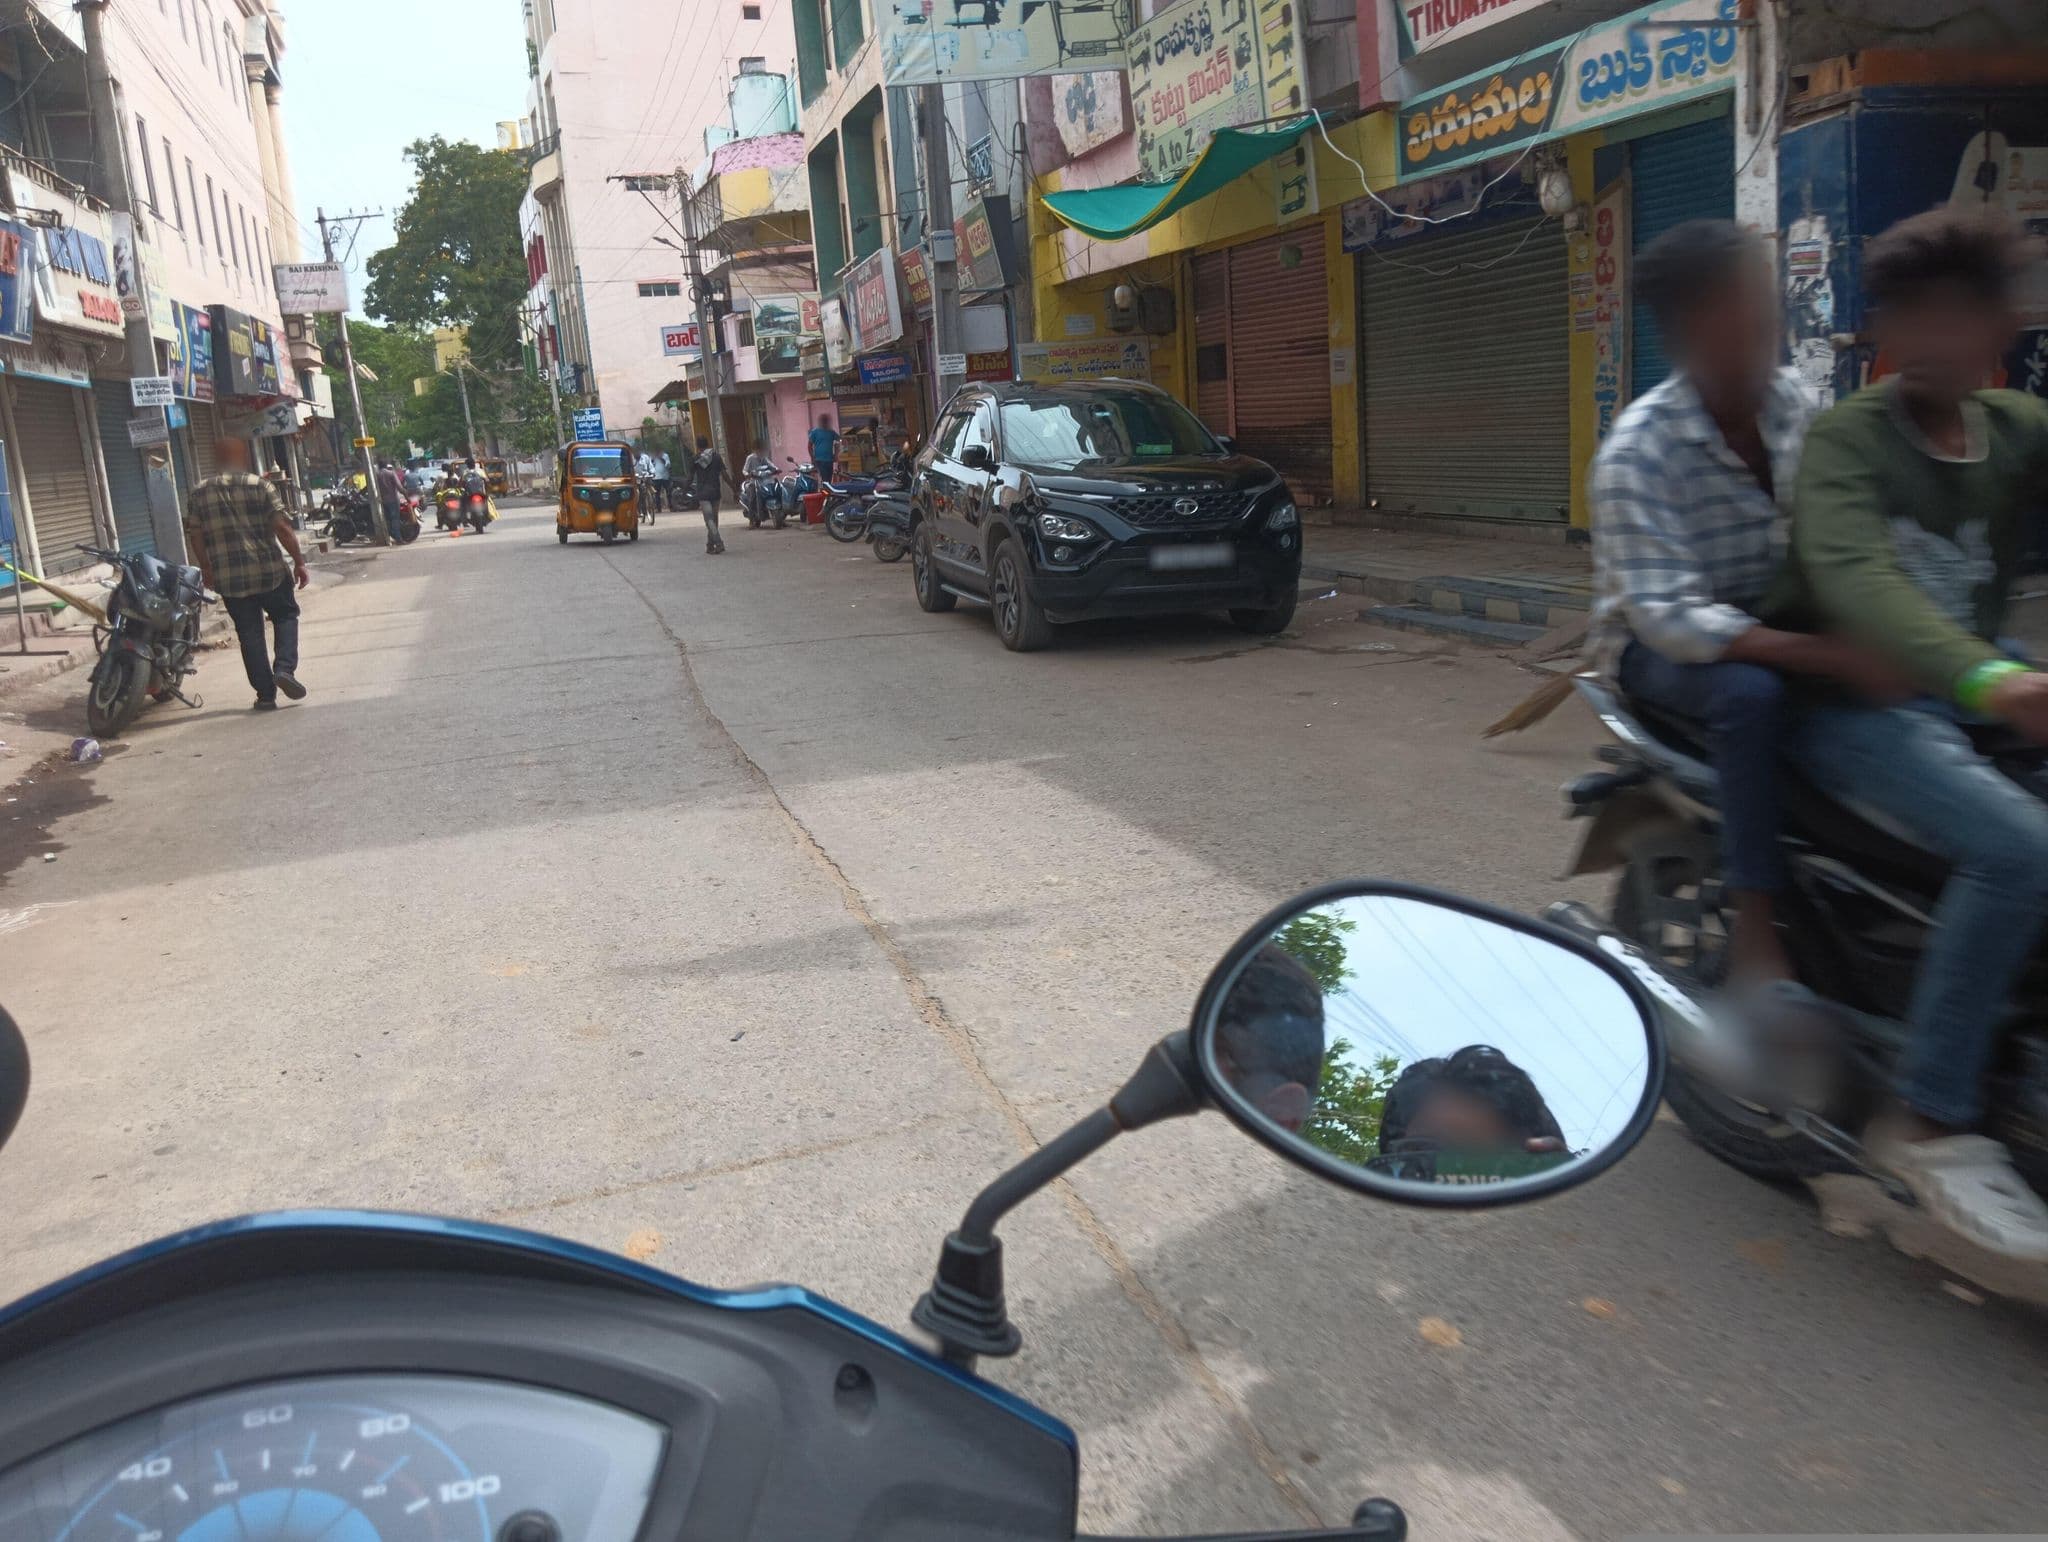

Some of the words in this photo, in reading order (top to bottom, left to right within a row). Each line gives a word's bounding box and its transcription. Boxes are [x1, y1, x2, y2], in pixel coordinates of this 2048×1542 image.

[1406, 71, 1552, 163] తిరుమల
[1158, 144, 1168, 171] A
[1169, 139, 1183, 165] to
[1184, 128, 1195, 153] Z
[303, 264, 339, 273] KRISHNA
[242, 1404, 293, 1429] 60
[359, 1413, 411, 1439] 80
[117, 1457, 172, 1481] 40
[438, 1474, 501, 1504] 100
